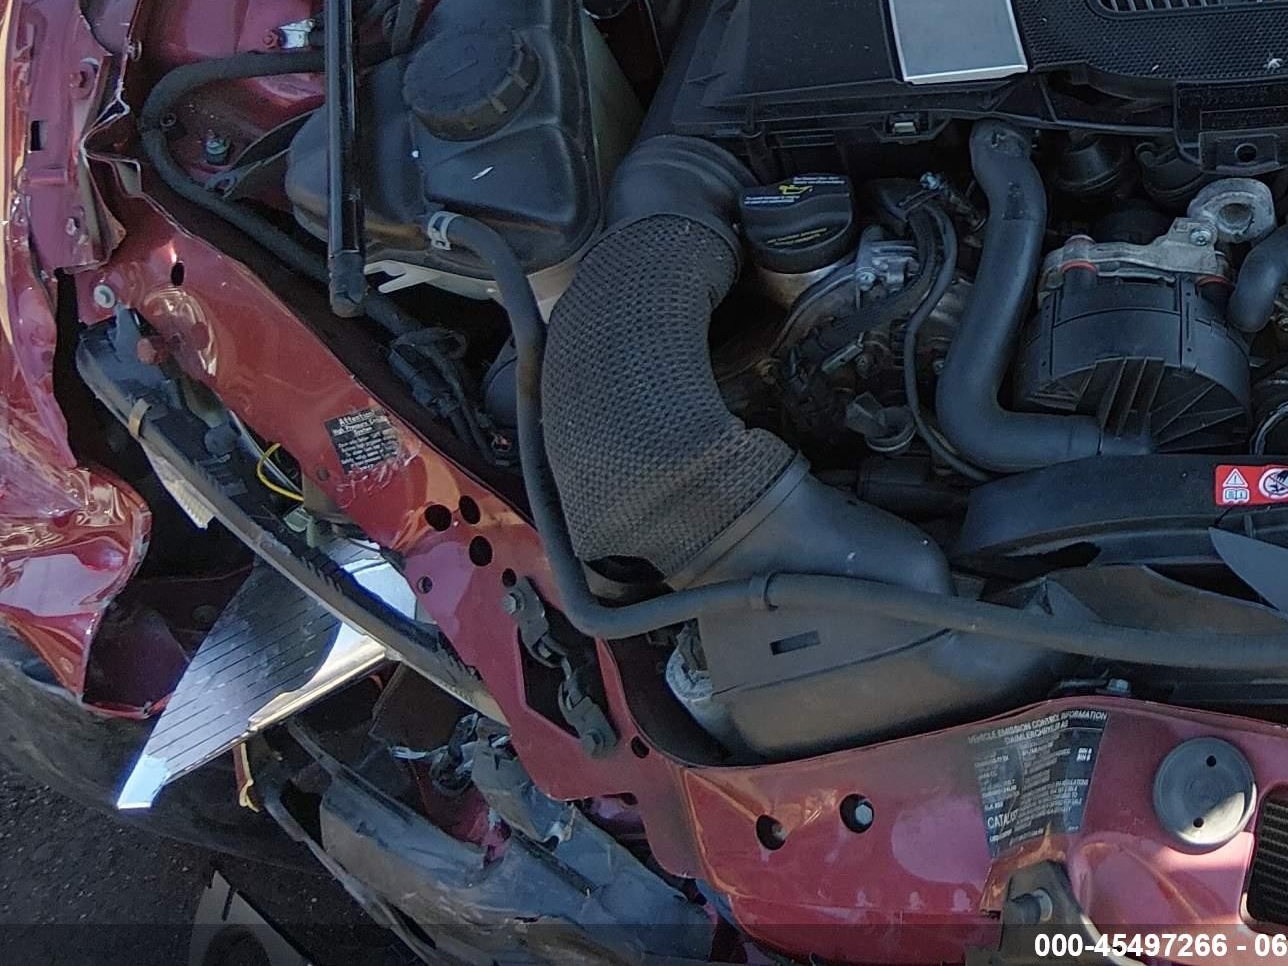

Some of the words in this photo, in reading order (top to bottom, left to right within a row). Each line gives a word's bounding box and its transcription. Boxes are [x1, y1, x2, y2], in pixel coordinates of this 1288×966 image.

[967, 730, 997, 744] VEHICLE
[997, 721, 1031, 737] EMISSION
[1031, 713, 1060, 729] CONTROL
[1060, 709, 1108, 721] INFORMATION
[987, 808, 1020, 829] CATALYST
